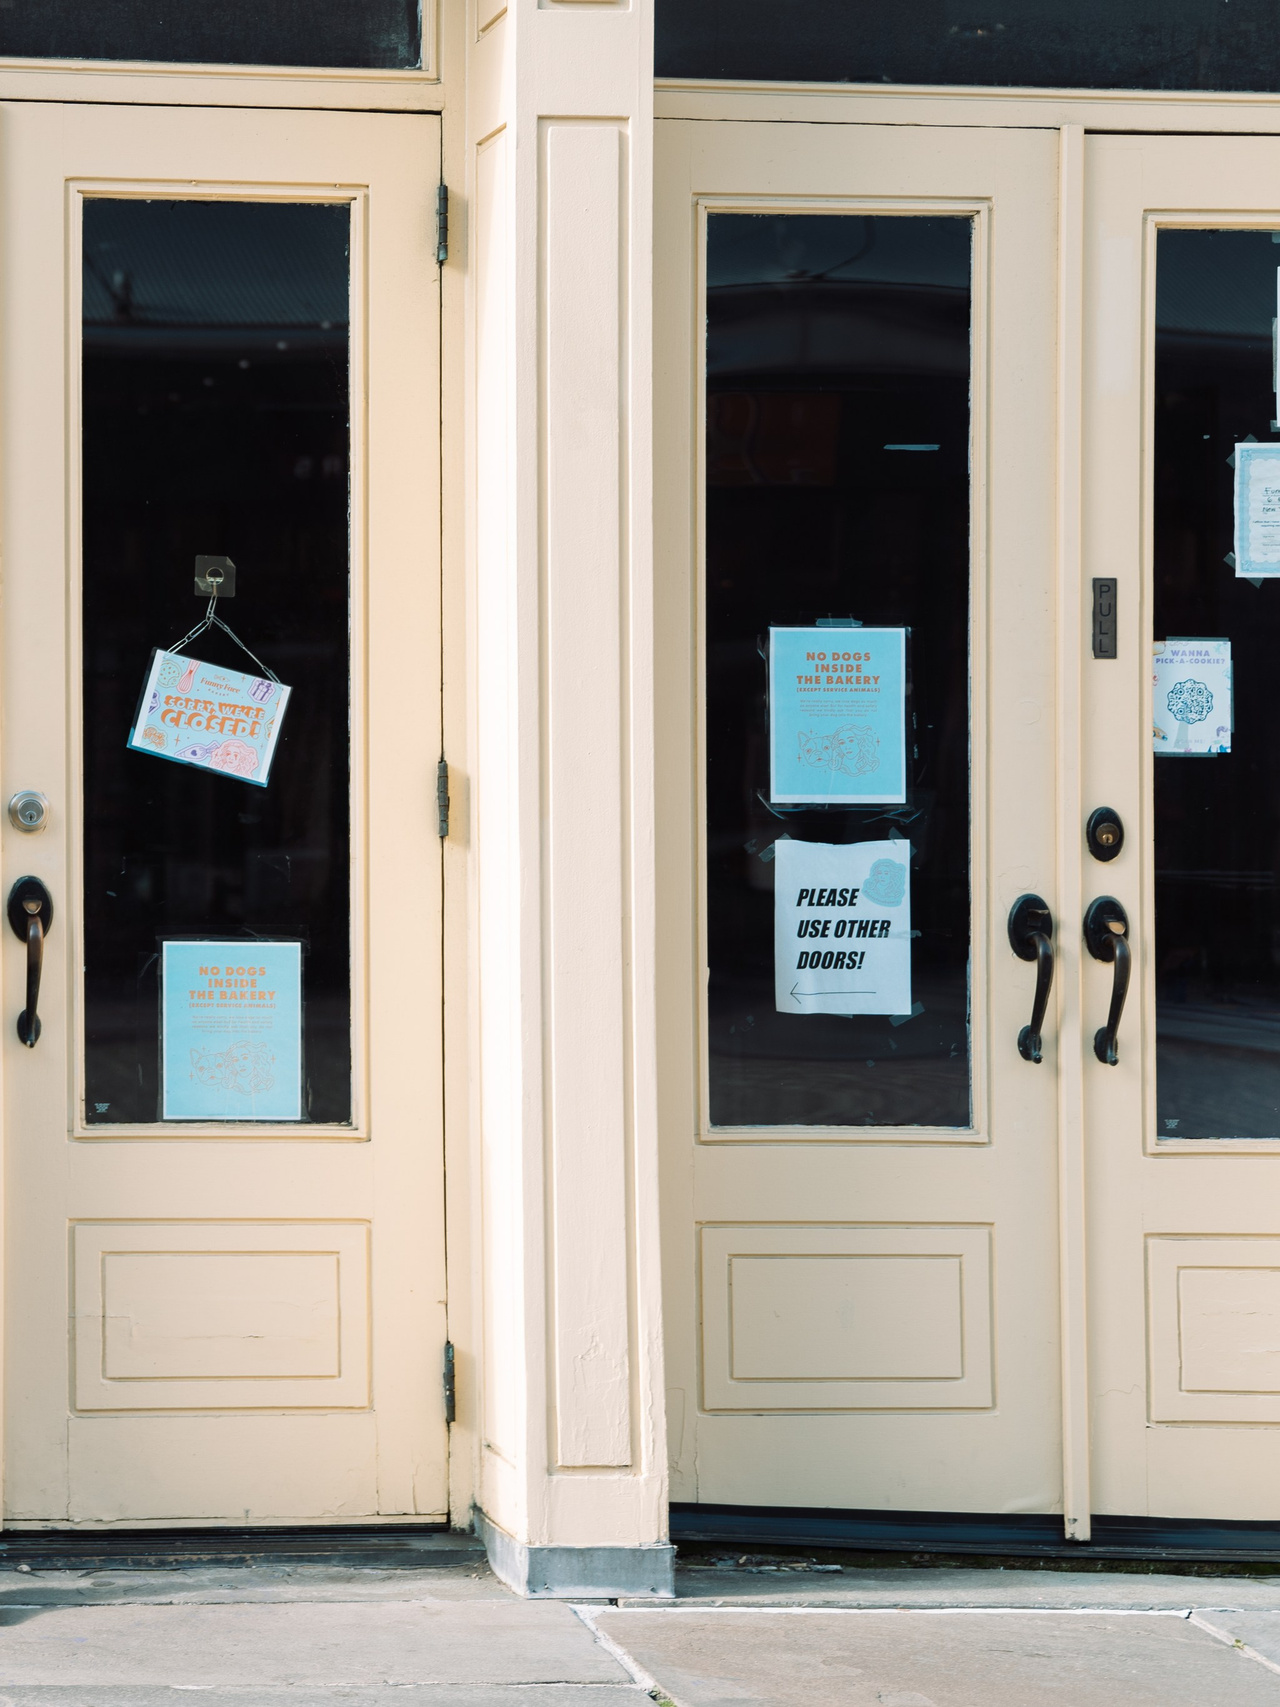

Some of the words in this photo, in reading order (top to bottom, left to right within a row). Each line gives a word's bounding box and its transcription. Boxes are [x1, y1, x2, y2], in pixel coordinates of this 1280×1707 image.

[1099, 584, 1112, 654] PULL
[806, 652, 827, 661] NO
[831, 652, 871, 661] DOGS
[1170, 649, 1210, 657] WANNA
[1155, 657, 1226, 665] PICK-A-COOKIE?
[815, 663, 862, 673] INSIDE
[796, 675, 821, 684] THE
[826, 675, 880, 685] BAKERY
[163, 695, 216, 715] SORRY,
[218, 702, 266, 720] WE'RE
[161, 709, 261, 739] CLOSED!
[796, 888, 860, 907] PLEASE
[797, 920, 832, 938] USE
[834, 920, 891, 938] OTHER
[796, 951, 866, 970] DOORS!
[199, 966, 220, 976] NO
[225, 966, 266, 976] DOGS
[208, 978, 257, 988] INSIDE
[189, 990, 215, 1000] THE
[219, 990, 276, 1000] BAKERY
